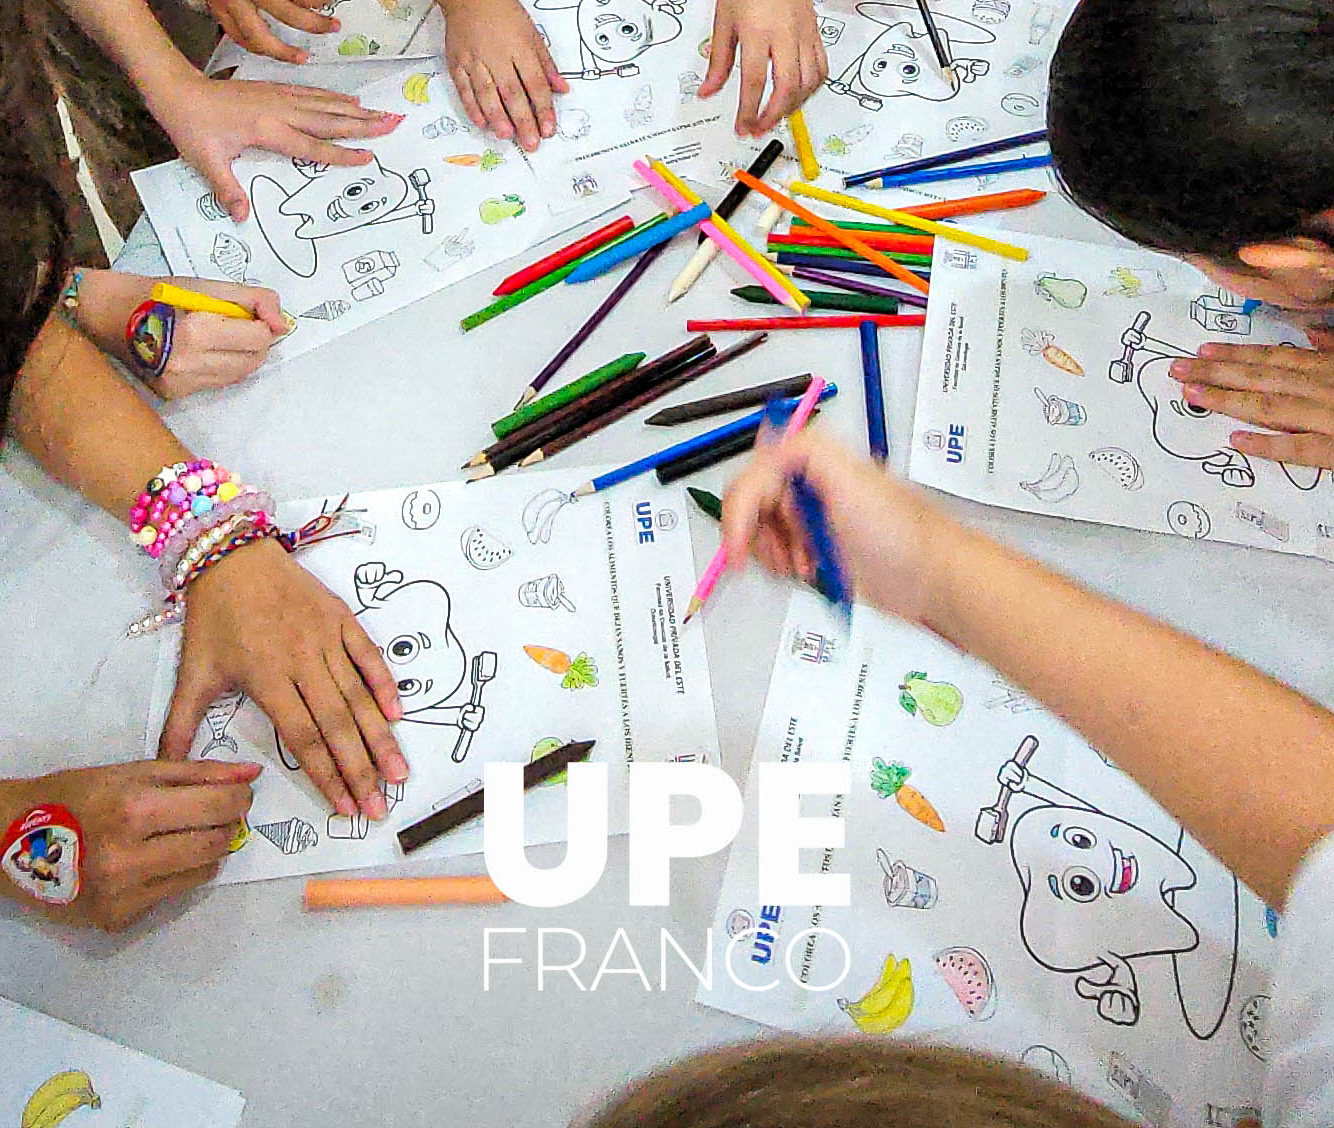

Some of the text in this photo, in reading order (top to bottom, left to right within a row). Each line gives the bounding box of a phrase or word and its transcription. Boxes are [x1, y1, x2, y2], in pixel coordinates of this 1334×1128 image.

[947, 424, 964, 463] UPE
[635, 501, 655, 544] UPE
[662, 576, 675, 625] UNIVERSIDAD
[670, 626, 680, 658] PRIVADA
[676, 677, 685, 694] ESTE
[623, 719, 631, 736] LOS
[750, 902, 780, 965] UPE
